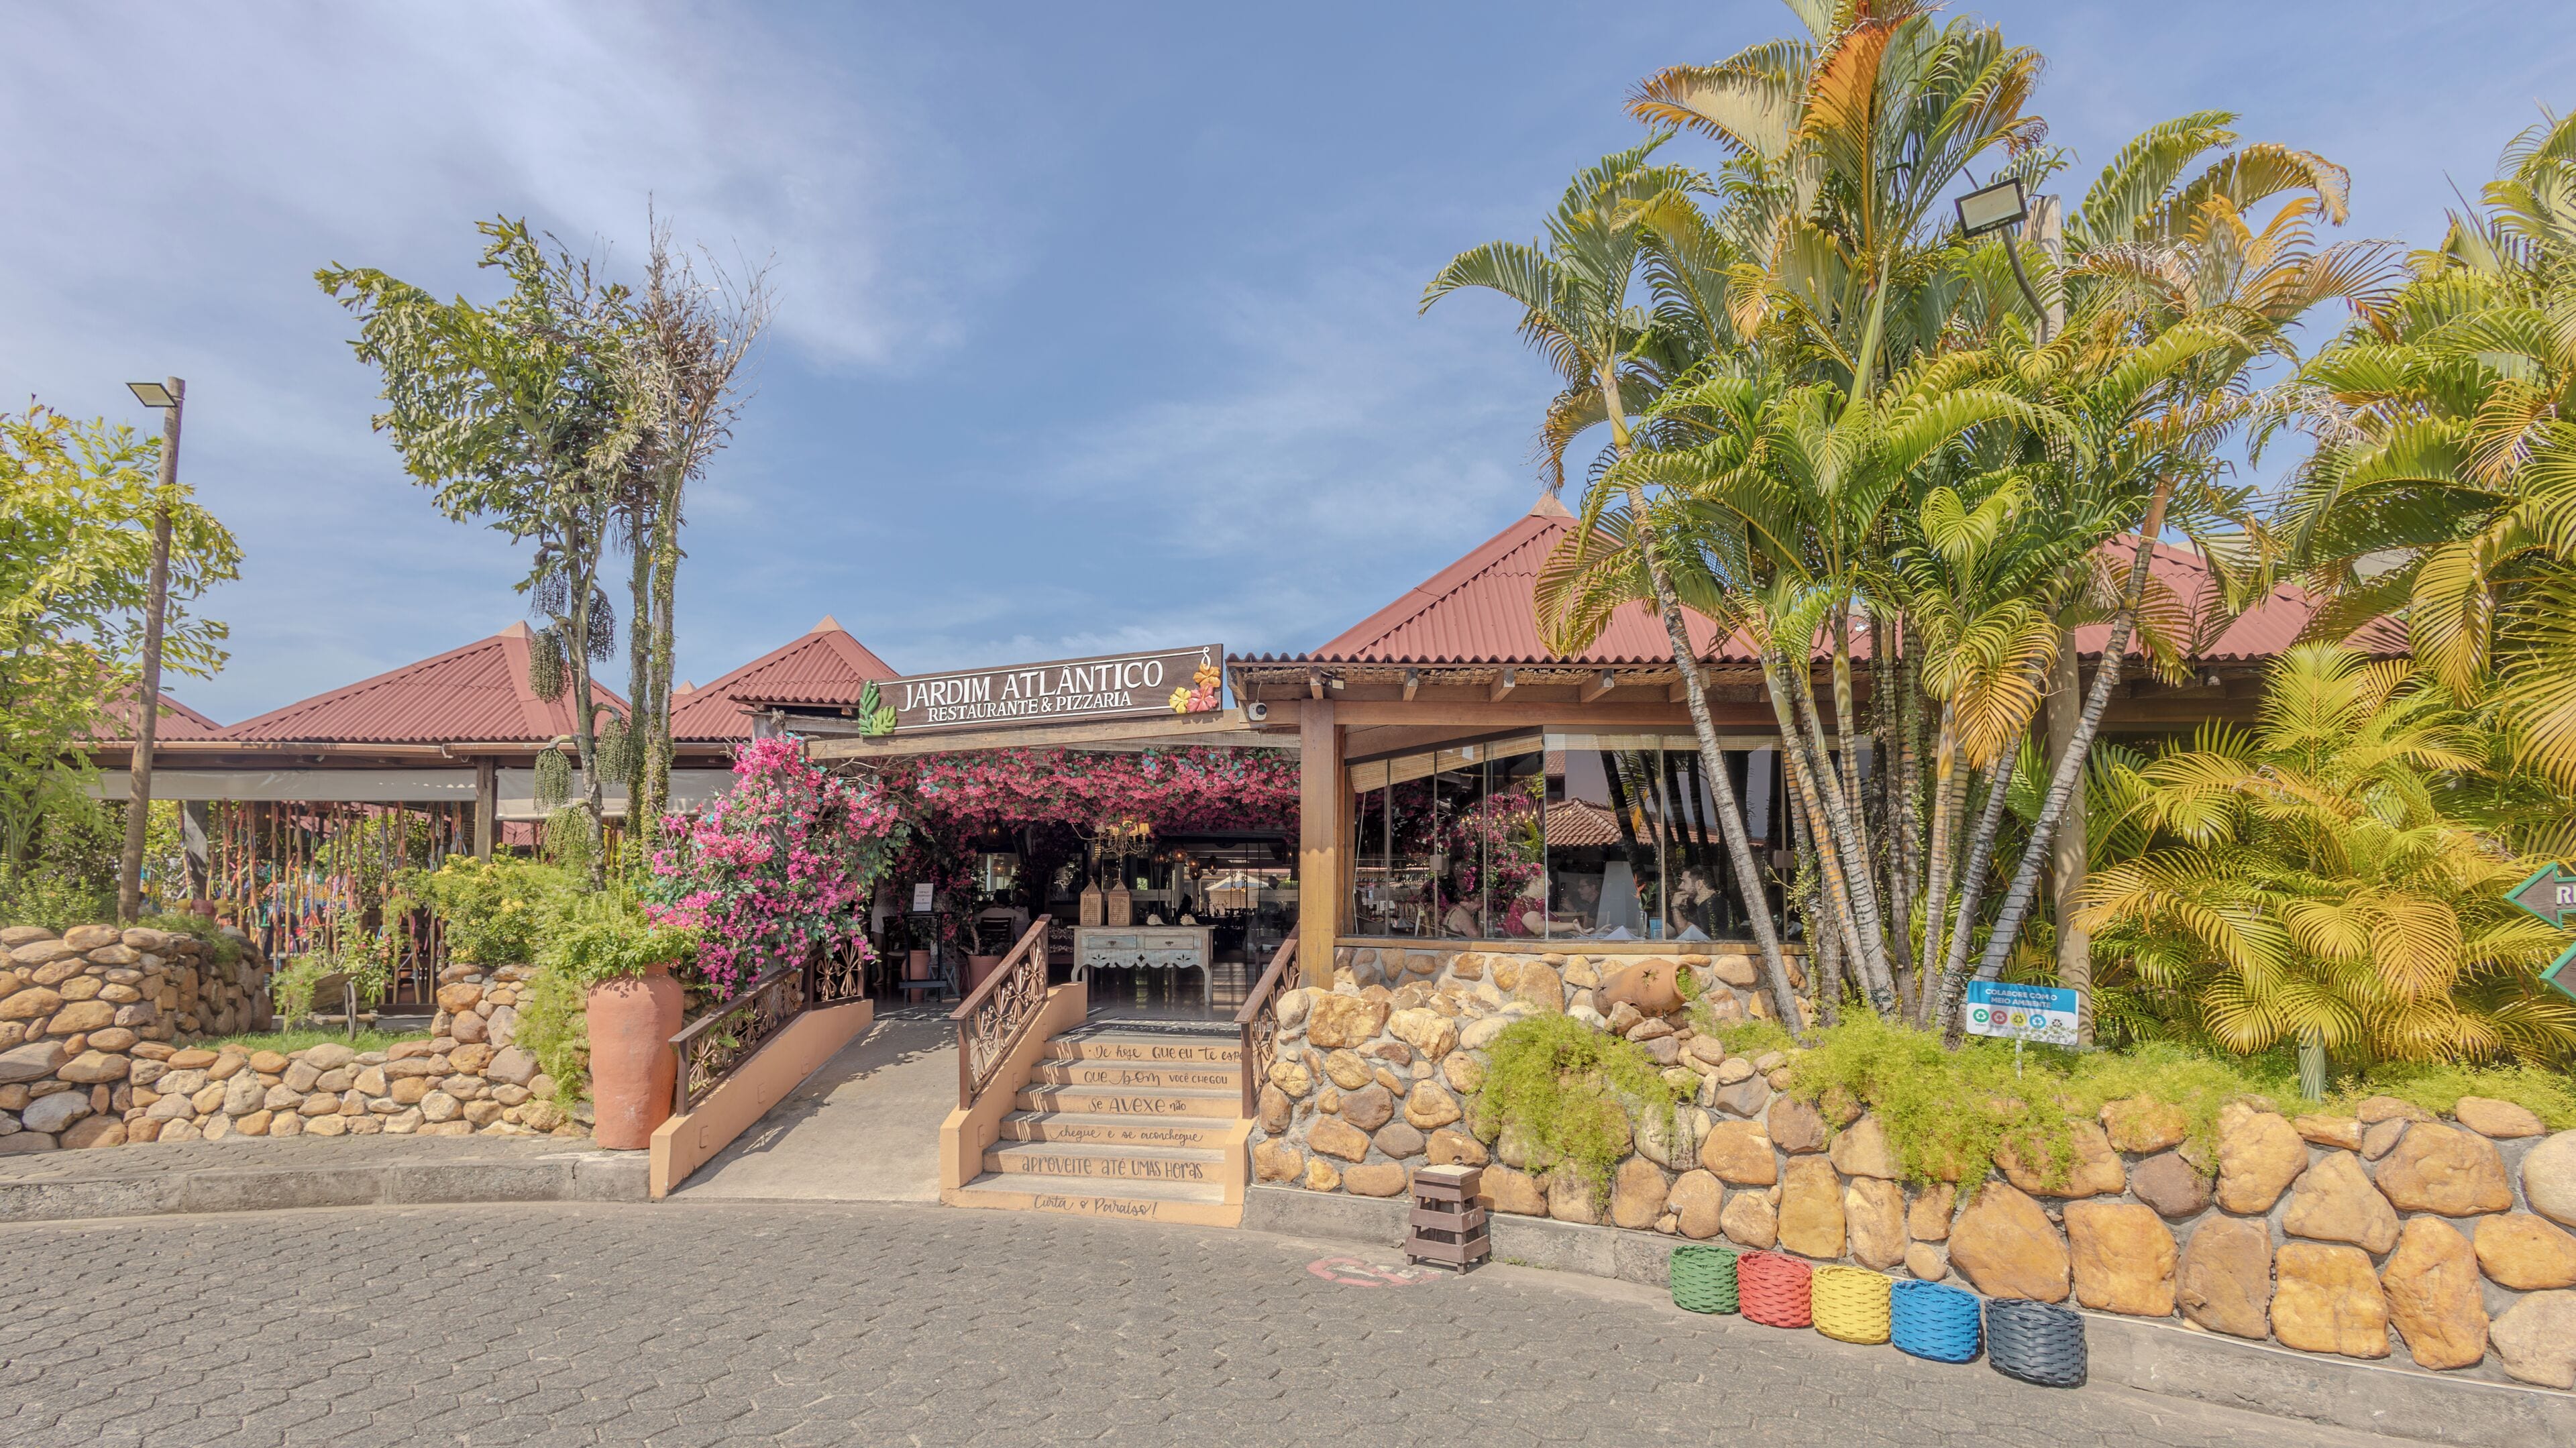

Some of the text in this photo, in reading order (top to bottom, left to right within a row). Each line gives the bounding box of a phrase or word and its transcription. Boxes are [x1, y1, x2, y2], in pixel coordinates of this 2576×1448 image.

[898, 660, 1164, 712] JARDIM ATLÂNTICO
[927, 691, 1134, 722] RESTAURANTE & PIZZARIA
[2556, 885, 2576, 904] R
[1985, 989, 2027, 998] COLABORE
[2012, 999, 2051, 1008] AMBIENTE
